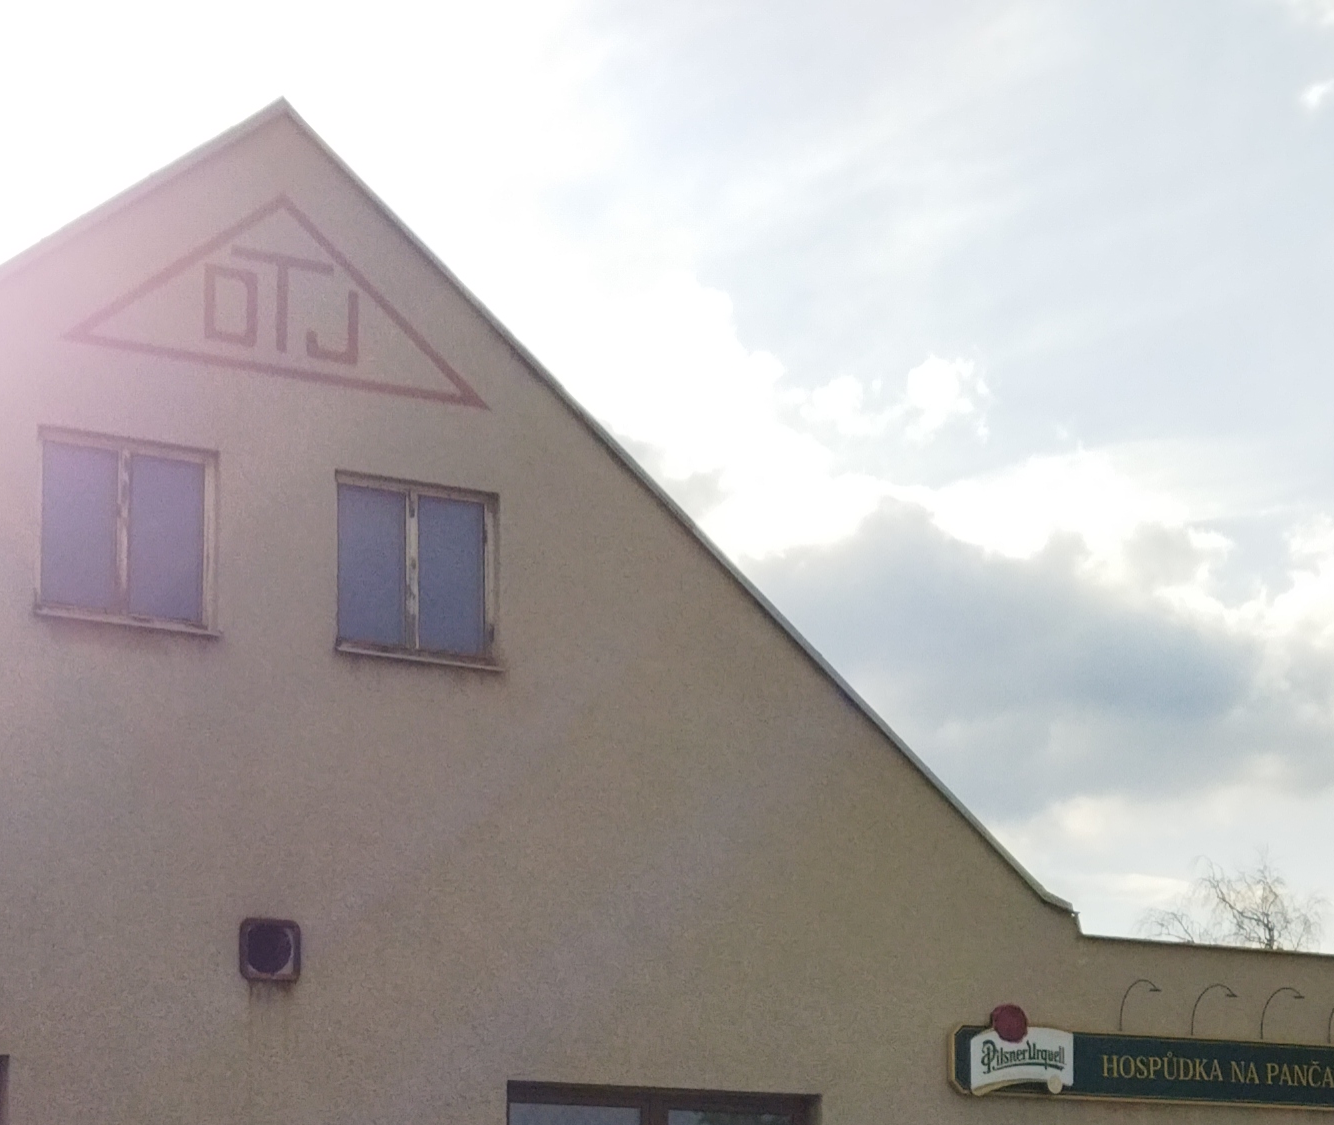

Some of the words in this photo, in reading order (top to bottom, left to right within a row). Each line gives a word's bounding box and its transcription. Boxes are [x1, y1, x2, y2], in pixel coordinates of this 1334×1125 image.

[981, 1039, 1029, 1074] Pilsner
[1026, 1040, 1065, 1070] Urquell
[1102, 1051, 1223, 1081] HOSPŮDKA
[1230, 1061, 1259, 1084] NA
